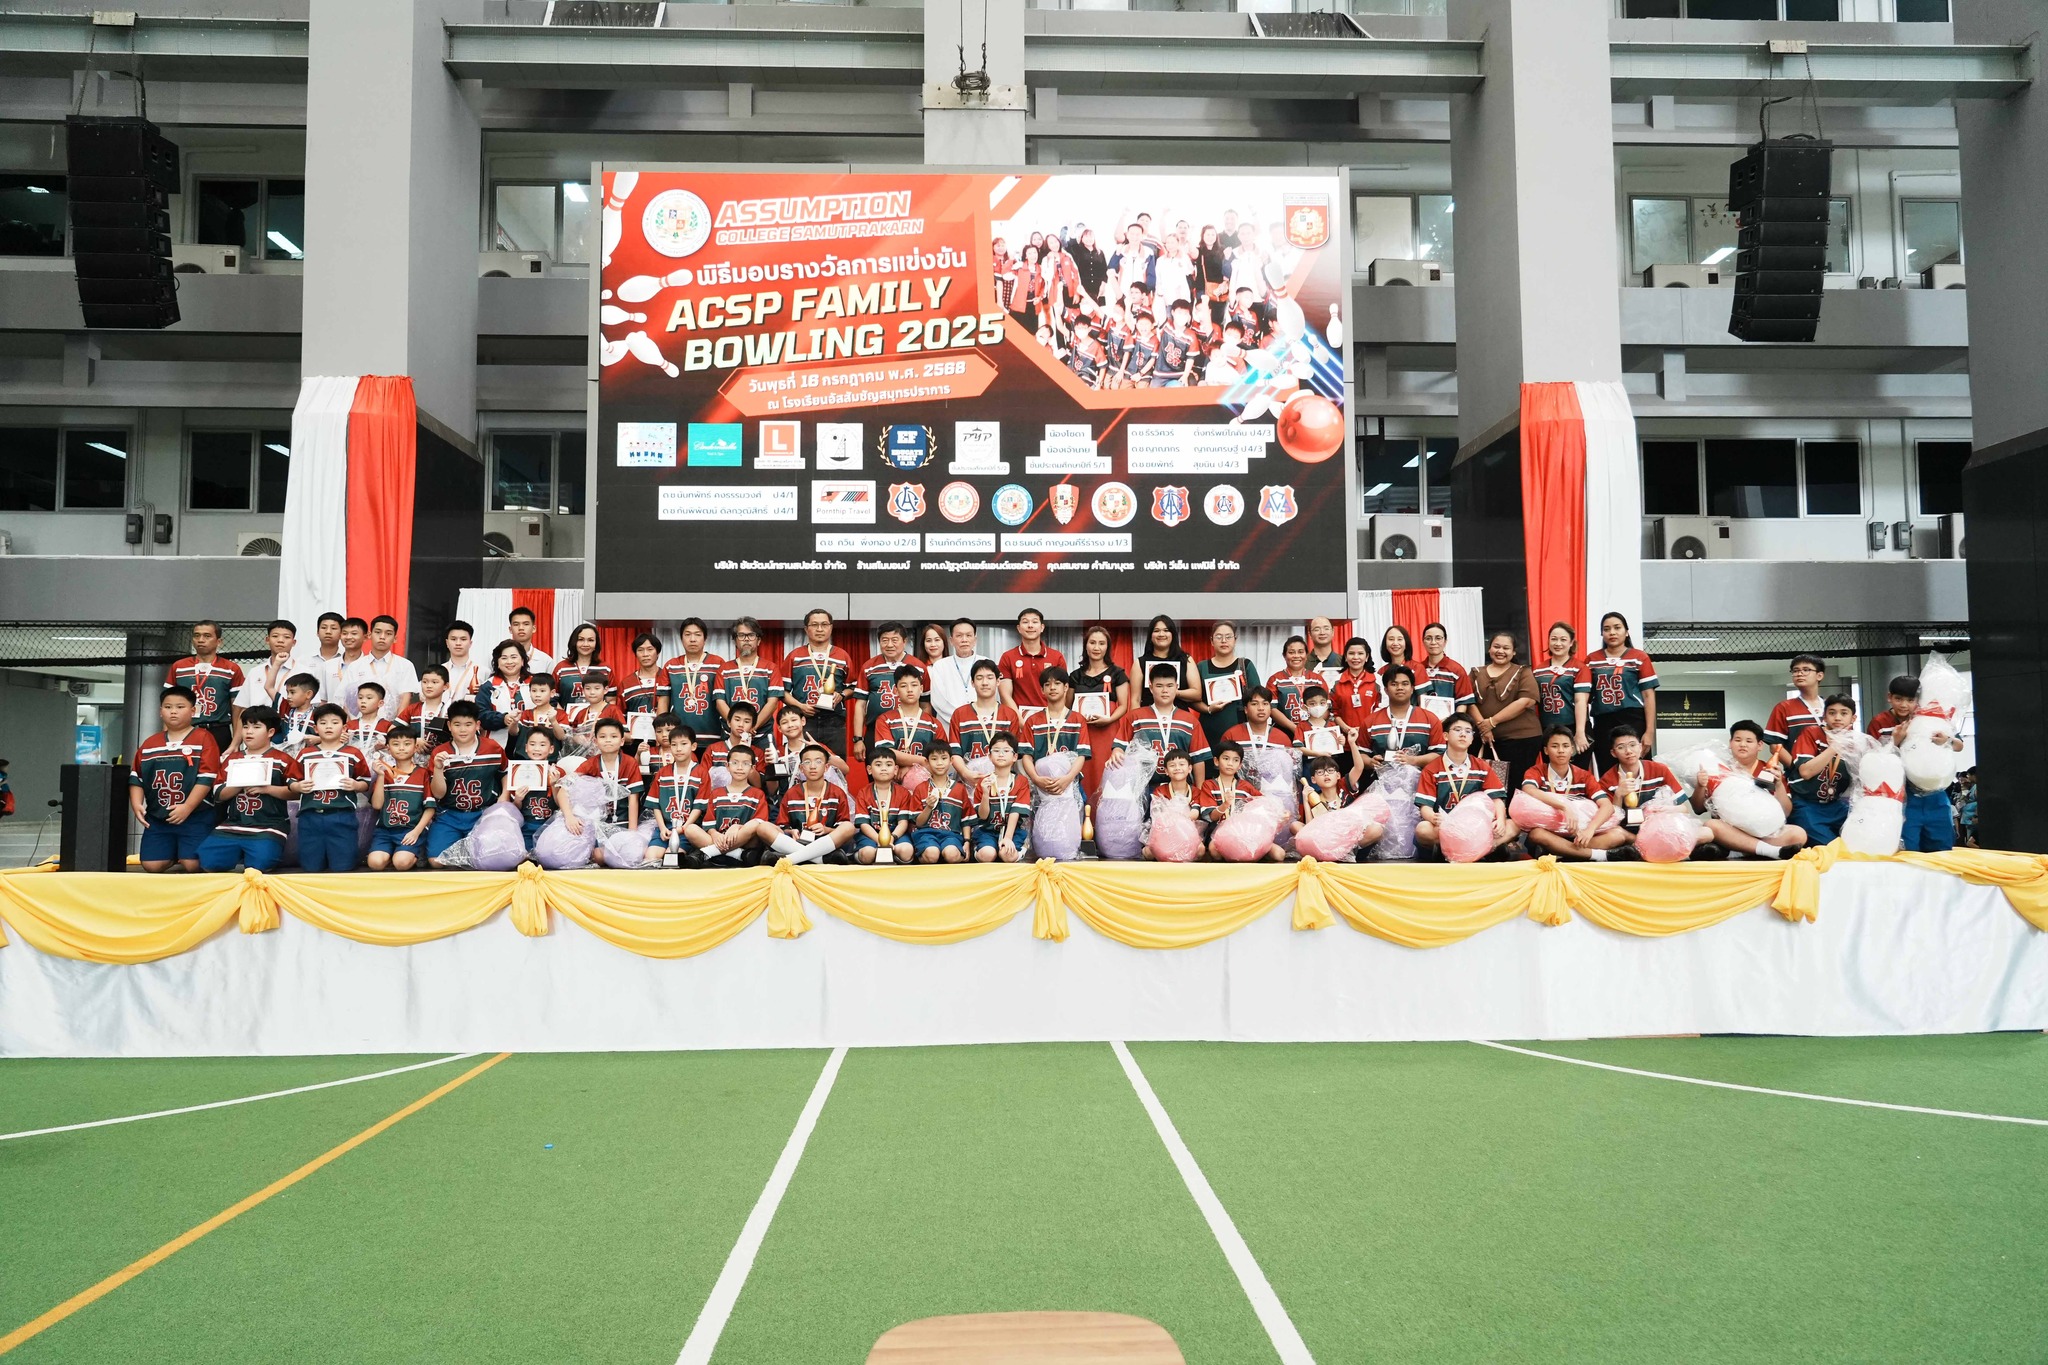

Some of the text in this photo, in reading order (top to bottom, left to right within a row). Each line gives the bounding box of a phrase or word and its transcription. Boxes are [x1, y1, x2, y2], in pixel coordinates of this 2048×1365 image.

[715, 190, 912, 229] ASSUMPTION
[715, 219, 925, 247] COLLEGE SAMUTPRAKARN
[696, 249, 968, 287] พิธีมอบรางวัลการแข่งขัน
[665, 276, 952, 334] ACSP FAMILY
[684, 312, 1007, 373] BOWLING 2025
[748, 361, 966, 396] วันพุธที่ 16 กรกฎาคม พ.ศ. 2568
[767, 383, 952, 411] ณ โรงเรียนอัสสัมชัญสมุทรปราการ
[897, 431, 918, 444] EF
[1093, 461, 1106, 469] 5/1
[816, 507, 847, 515] Pornthip
[714, 560, 739, 570] บริษัท
[824, 559, 847, 570] จำกัด
[1143, 560, 1168, 570] บริษัท
[1217, 560, 1240, 570] จำกัด
[679, 682, 706, 701] AC
[1541, 682, 1562, 700] AC
[1596, 673, 1624, 691] AC
[731, 685, 759, 703] AC
[1601, 688, 1626, 707] SP
[683, 697, 709, 716] SP
[1543, 697, 1566, 715] SP
[152, 769, 184, 791] AC
[451, 778, 482, 797] AC
[158, 788, 186, 808] SP
[236, 794, 263, 816] SP
[386, 797, 410, 816] AC
[456, 795, 483, 813] SP
[529, 797, 549, 810] AC
[666, 796, 692, 815] AC
[389, 811, 411, 826] SP
